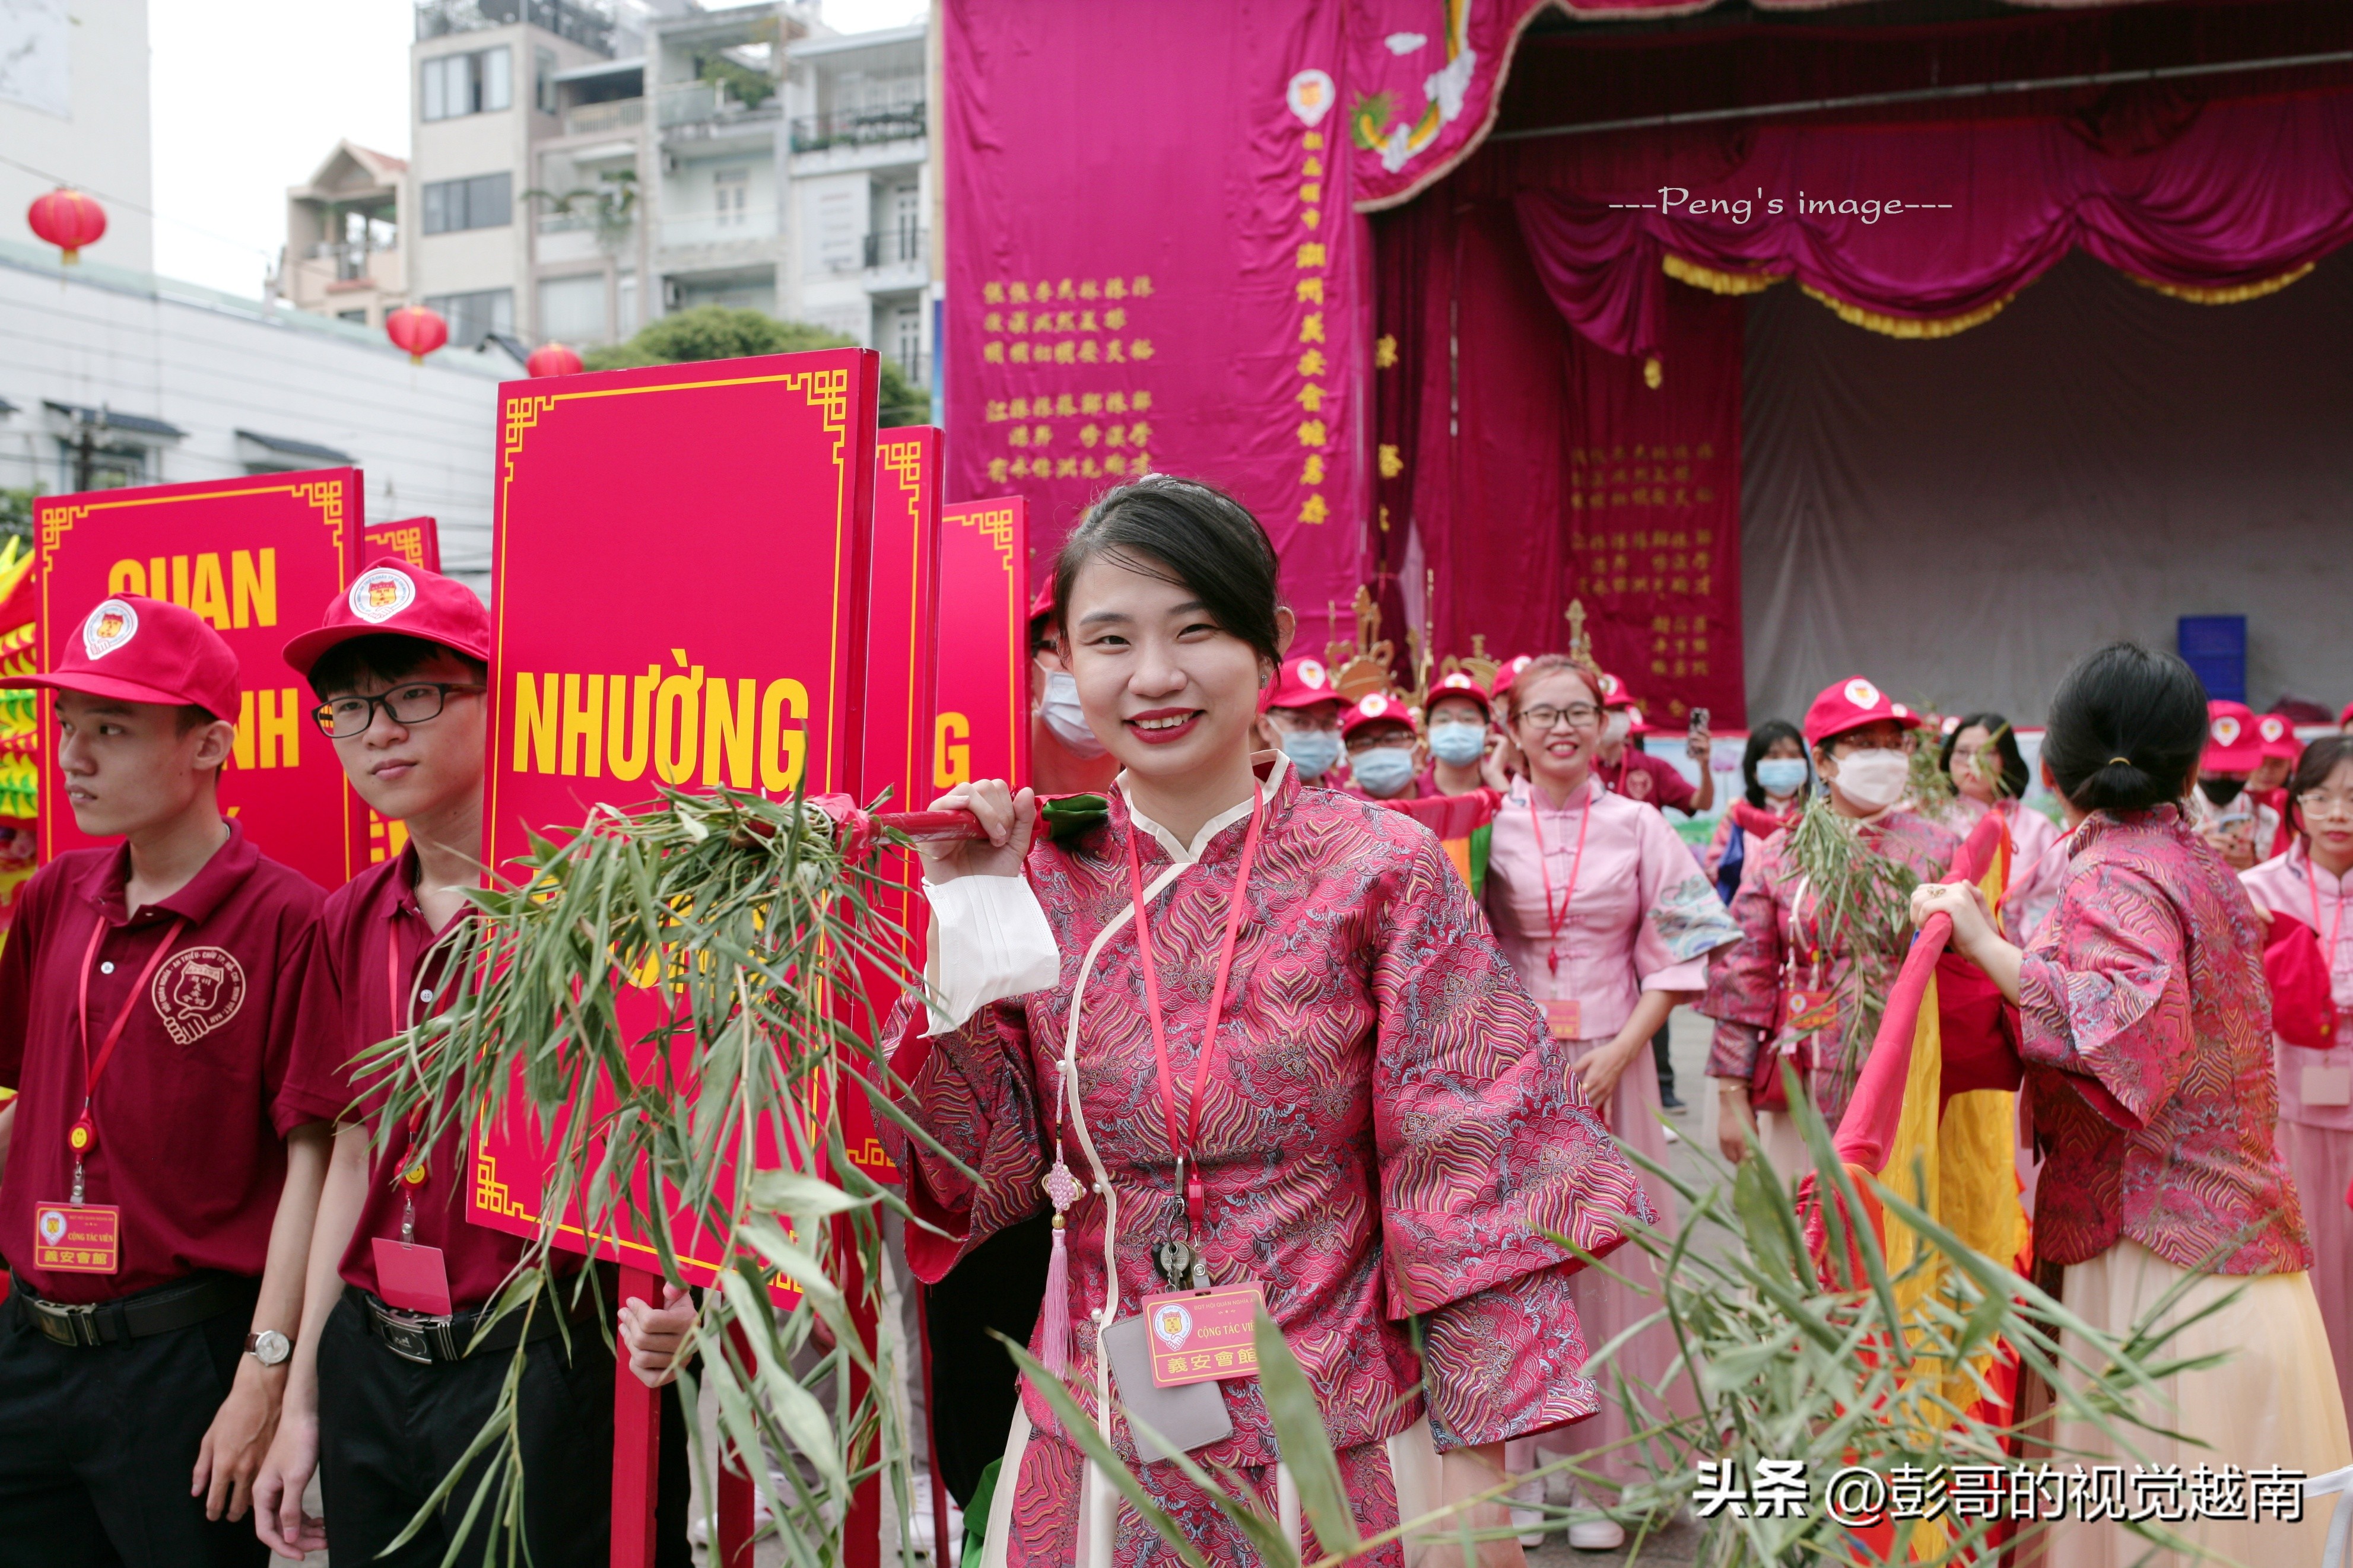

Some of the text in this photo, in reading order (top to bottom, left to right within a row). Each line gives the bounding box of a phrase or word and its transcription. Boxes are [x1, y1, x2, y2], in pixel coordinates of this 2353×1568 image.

[513, 648, 809, 793] NHƯỜNG
[1198, 1319, 1255, 1339] CỘNG TÁC VIÊ
[1167, 1348, 1258, 1373] 義安會館
